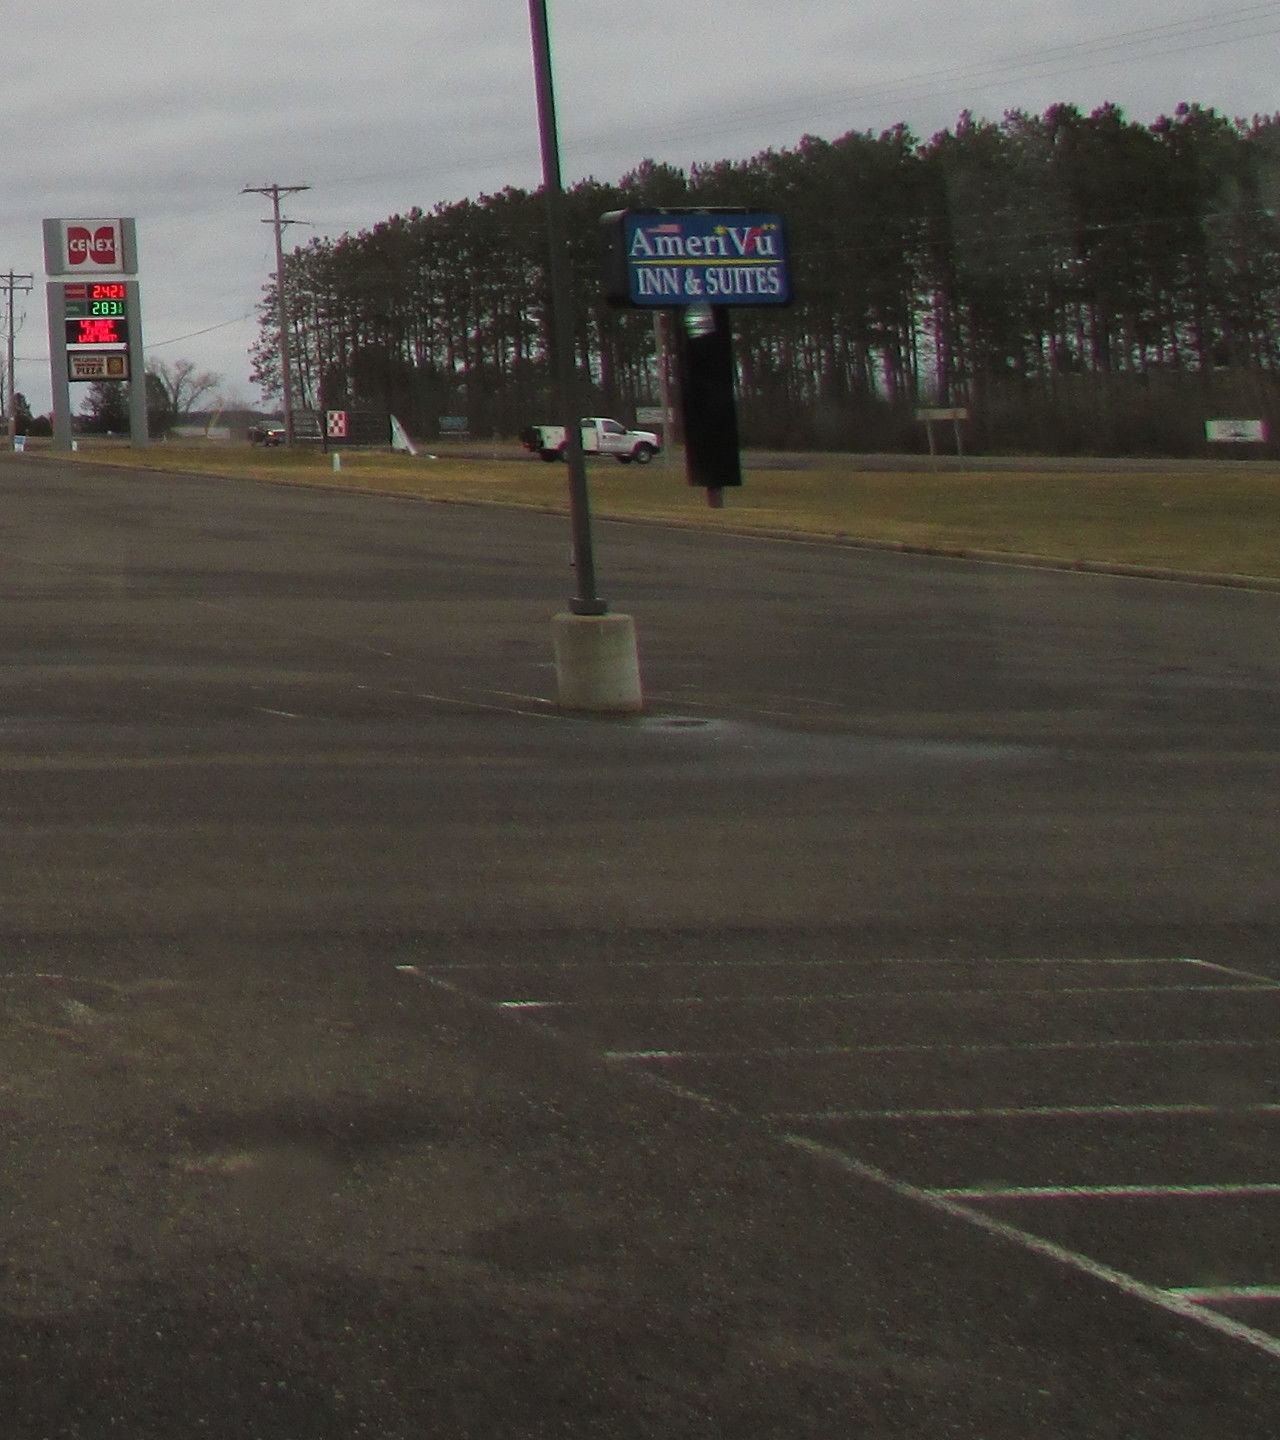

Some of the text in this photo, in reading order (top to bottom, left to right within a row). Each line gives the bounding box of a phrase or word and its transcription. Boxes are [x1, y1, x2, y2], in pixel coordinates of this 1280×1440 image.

[69, 238, 114, 252] CENEX
[630, 227, 775, 256] AmeriVu
[638, 267, 780, 295] INN & SUITES
